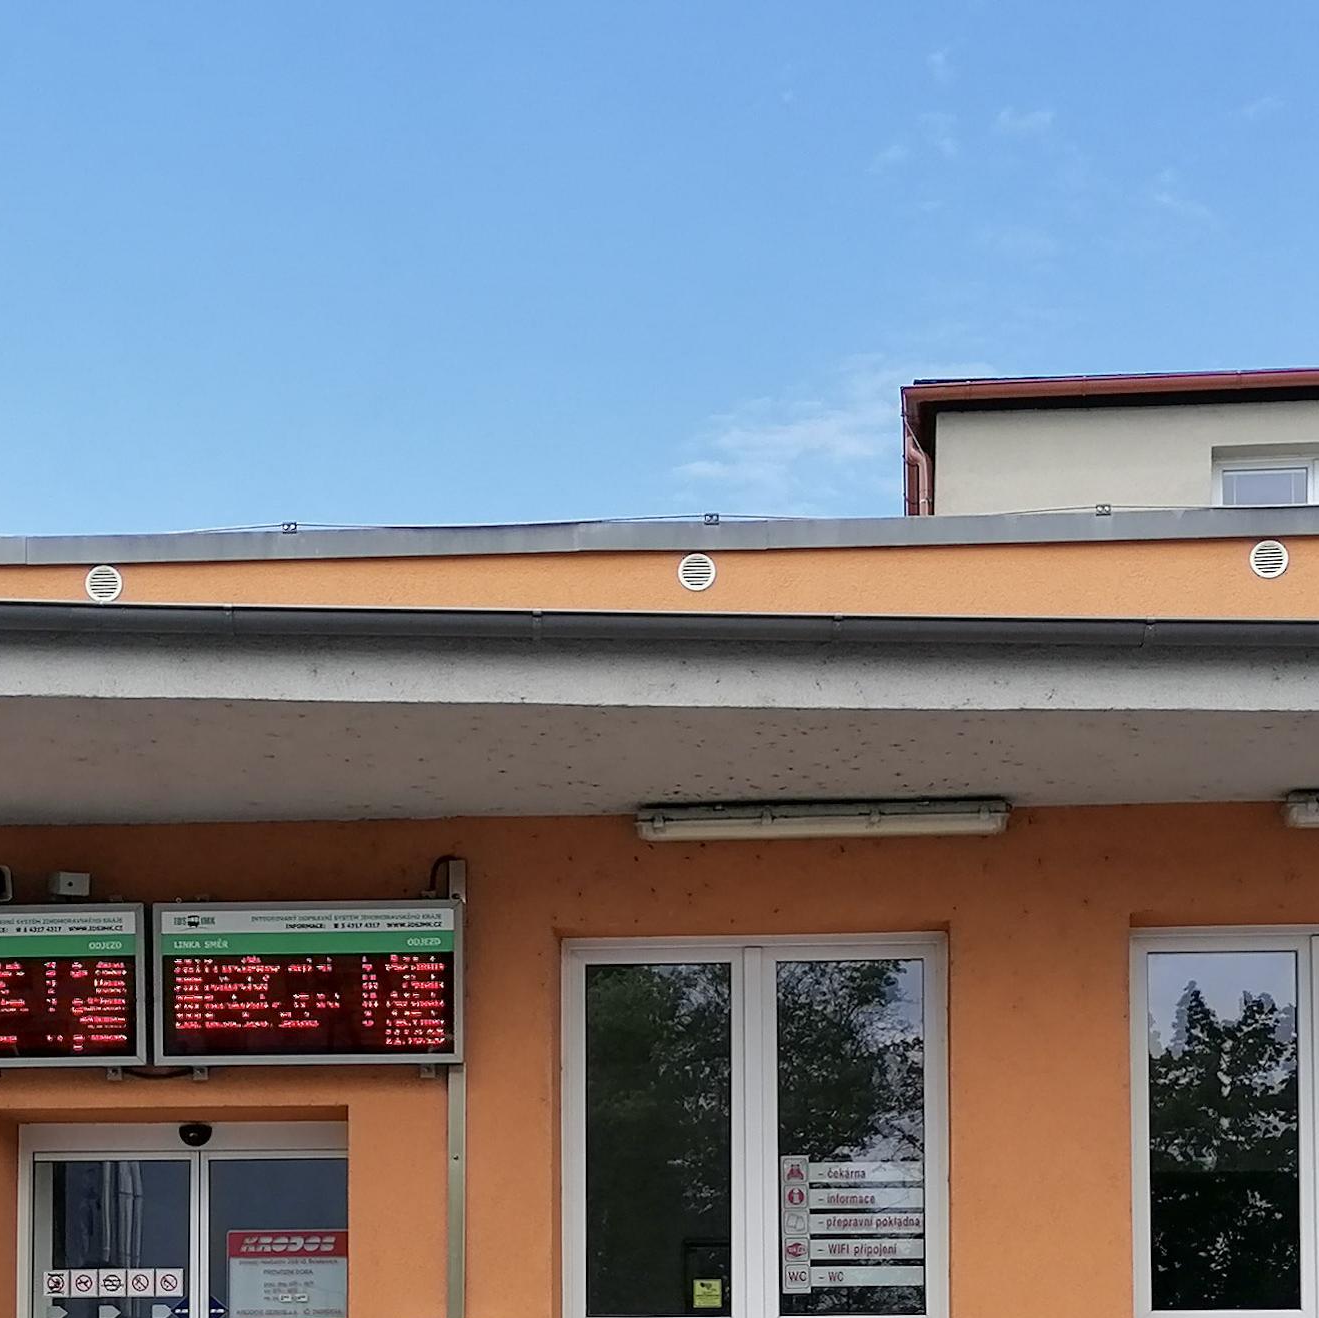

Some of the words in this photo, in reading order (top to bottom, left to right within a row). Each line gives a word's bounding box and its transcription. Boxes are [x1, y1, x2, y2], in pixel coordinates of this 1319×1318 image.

[173, 941, 201, 949] LINKA
[204, 938, 229, 948] SMĚR
[406, 938, 441, 946] ODJEZD
[827, 1167, 866, 1179] čekárna
[827, 1193, 875, 1204] informace
[826, 1214, 873, 1229] přepravní
[875, 1215, 921, 1228] pokladna
[828, 1244, 849, 1254] WIFI
[853, 1243, 897, 1256] připojení
[787, 1271, 807, 1281] WC
[828, 1271, 844, 1281] WC
